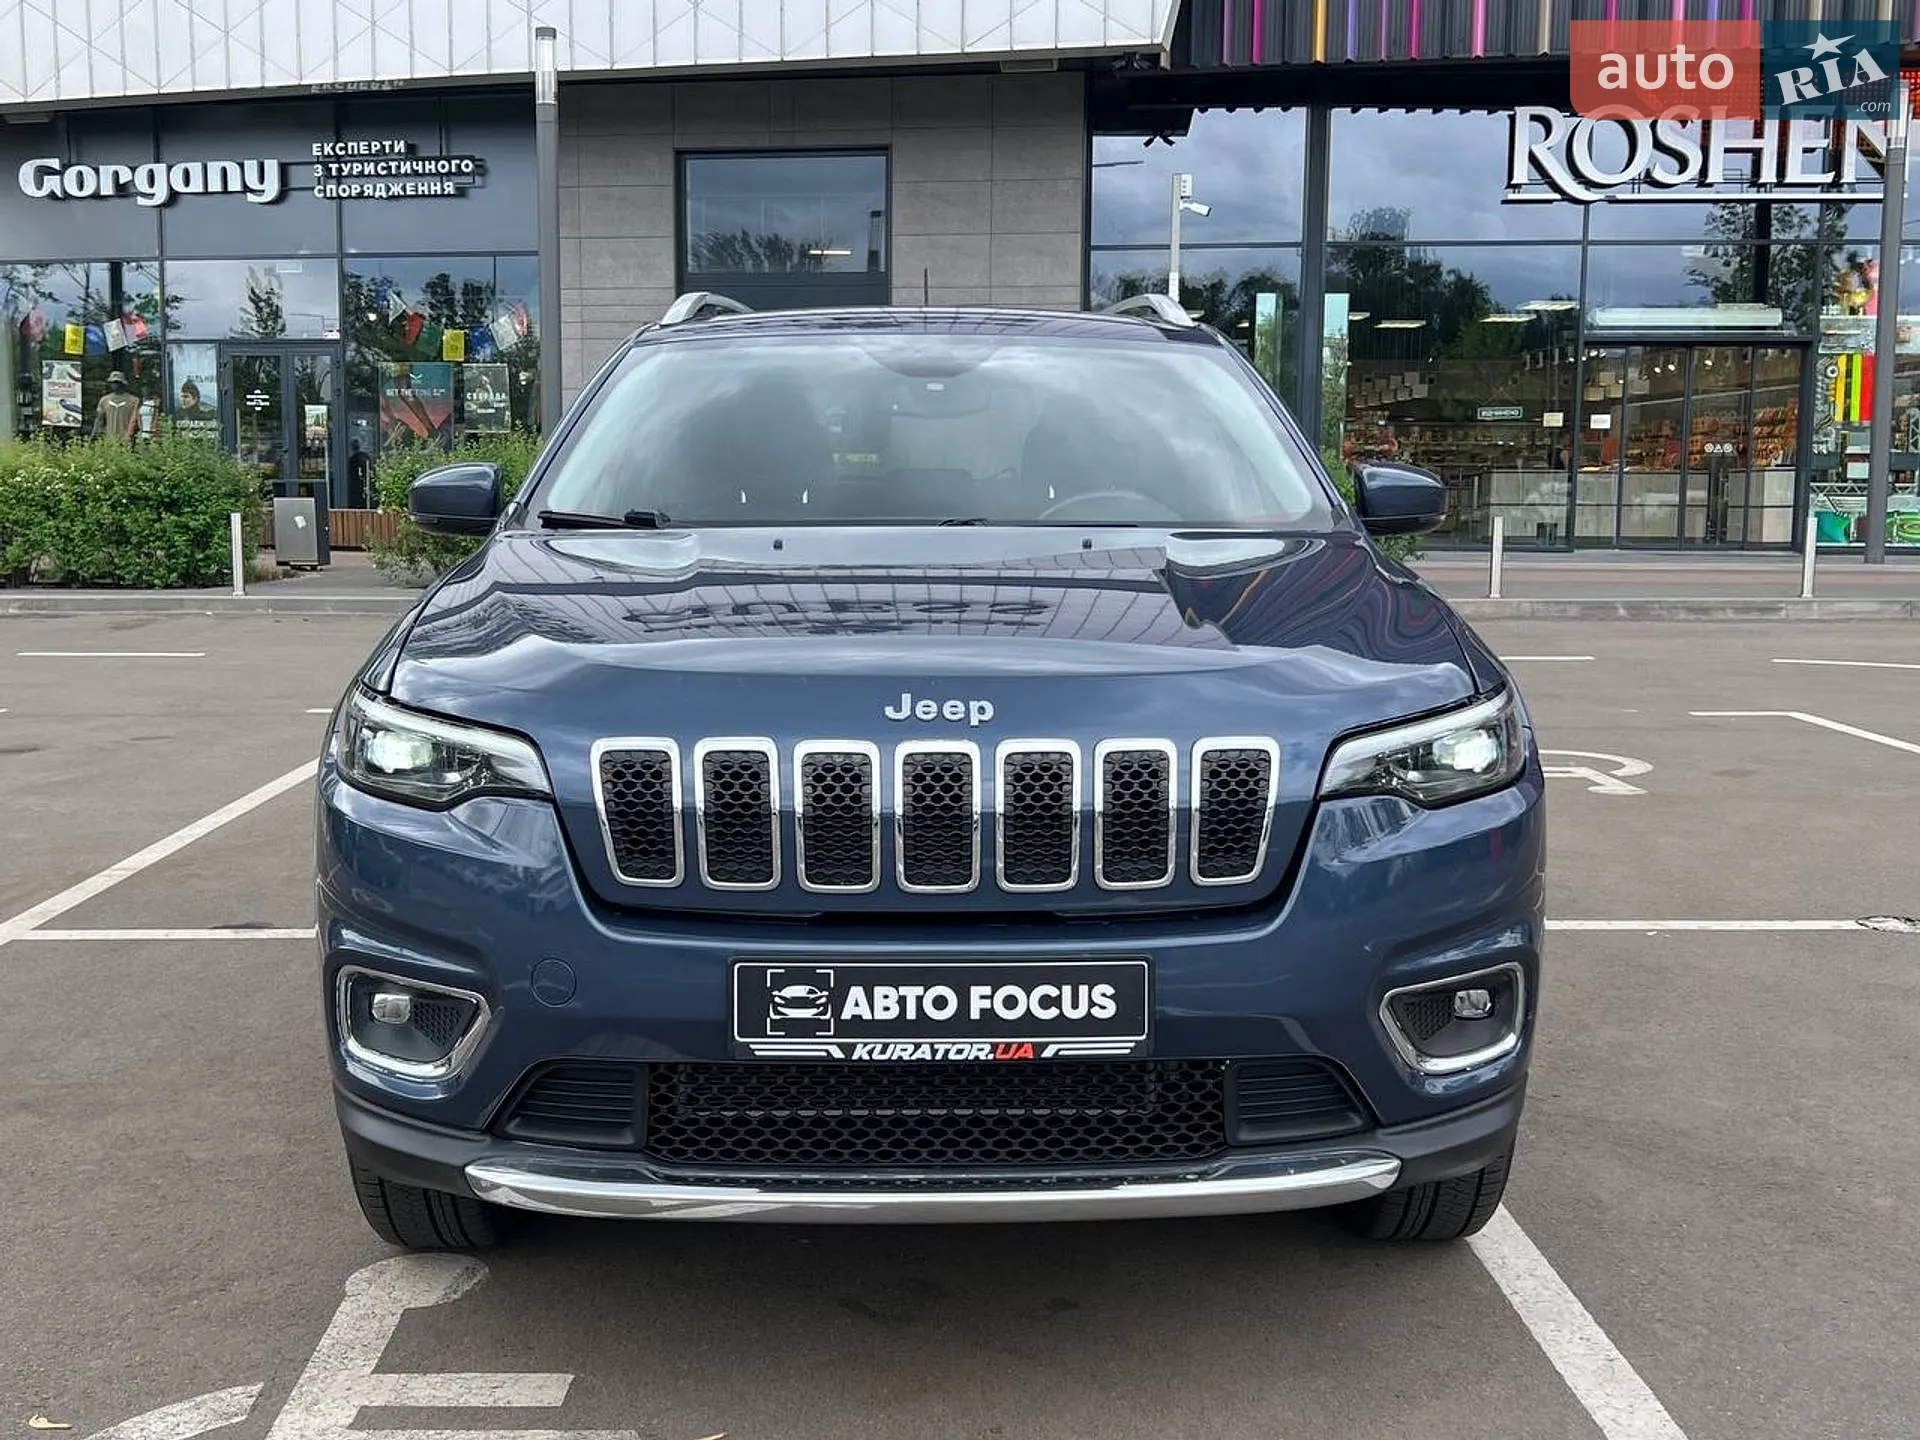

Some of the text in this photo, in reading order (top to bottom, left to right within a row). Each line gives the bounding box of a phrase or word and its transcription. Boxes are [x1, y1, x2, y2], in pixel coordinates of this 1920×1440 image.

[311, 139, 406, 157] ЕКСПЕРТИ
[328, 159, 474, 177] ТУРИСТИЧНОГО
[17, 157, 282, 207] Gorgany
[313, 181, 456, 198] СПОРЯДЖЕННЯ
[884, 692, 995, 727] Jeep
[840, 983, 1118, 1021] АВТО FOCUS
[851, 1042, 1036, 1061] KURATOR.UA
